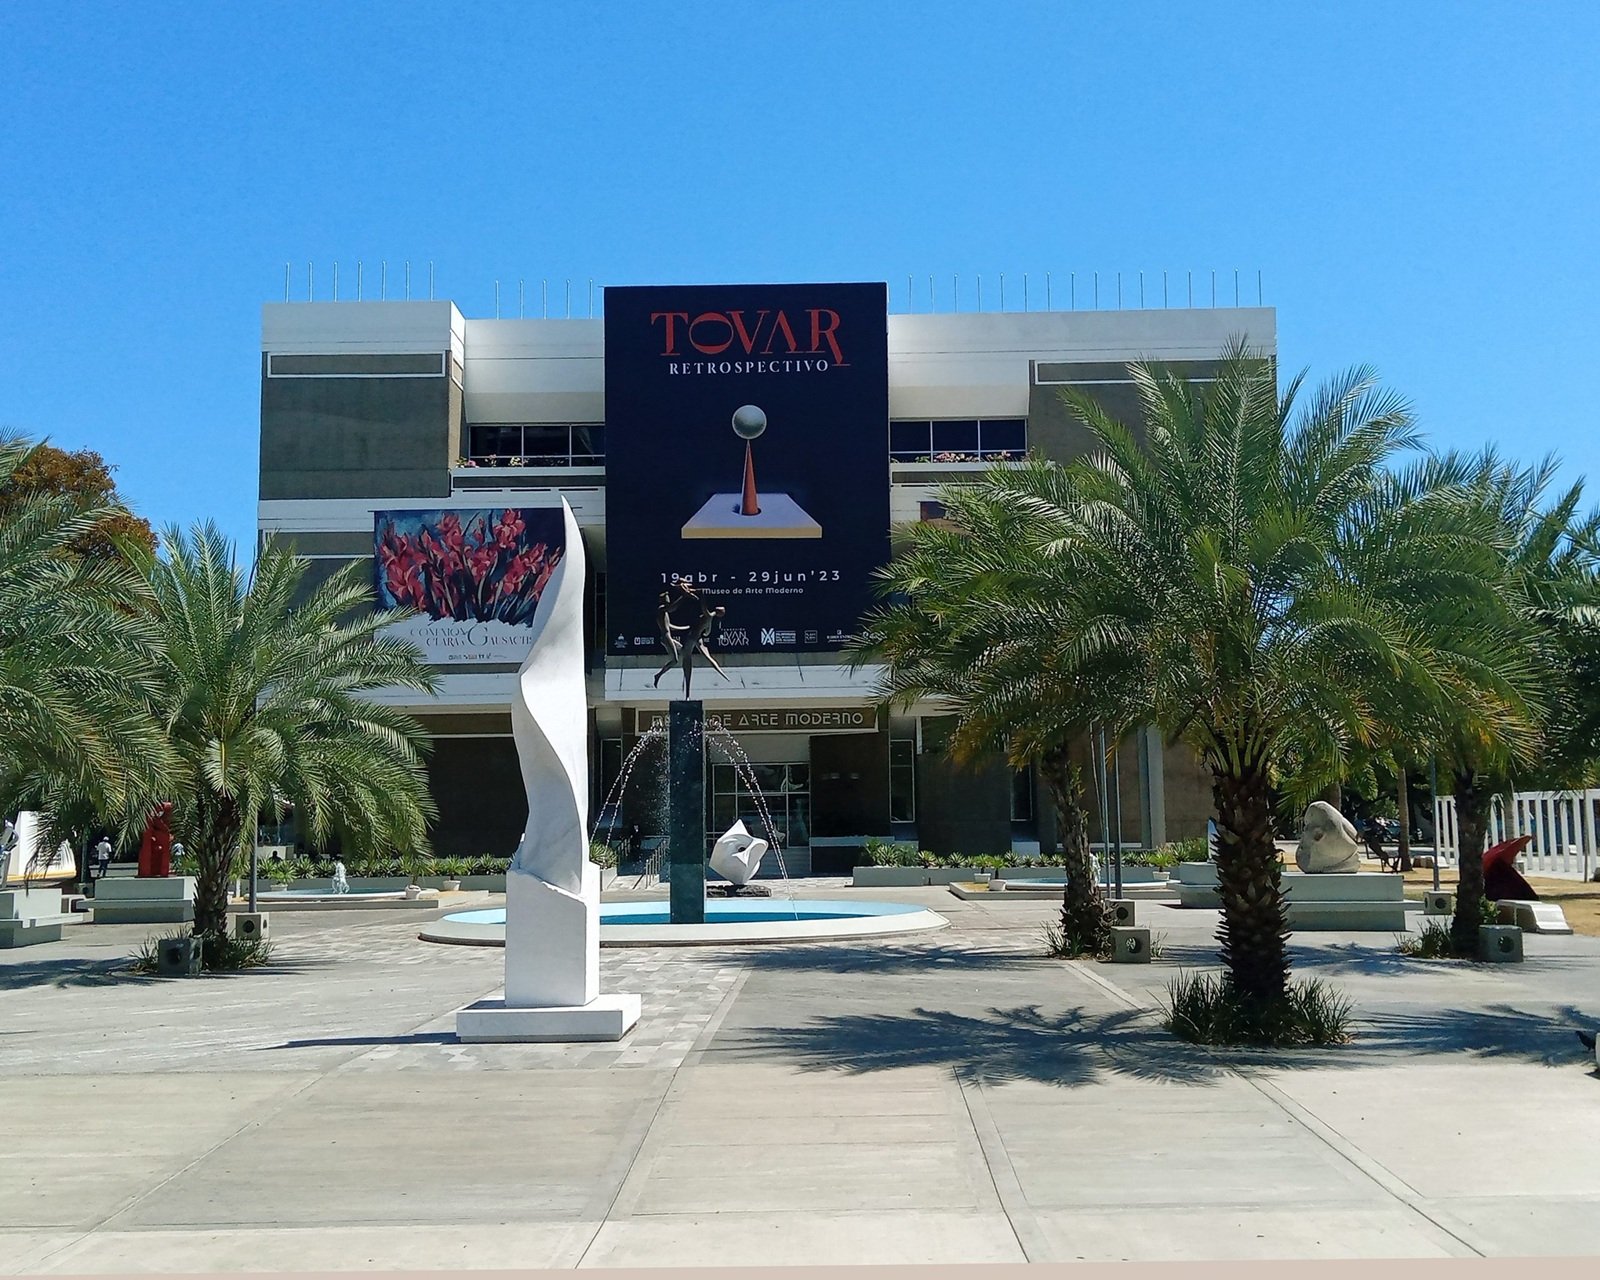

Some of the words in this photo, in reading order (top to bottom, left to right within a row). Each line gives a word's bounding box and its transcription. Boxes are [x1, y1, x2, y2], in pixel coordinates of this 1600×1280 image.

[651, 309, 851, 367] TOVAR
[669, 359, 829, 376] RETROSPECTIVO
[660, 571, 718, 584] 19abr
[702, 587, 731, 595] Museo
[732, 587, 742, 595] de
[745, 587, 763, 595] Arte
[765, 587, 804, 595] Moderno
[738, 713, 779, 726] ARTE
[785, 712, 863, 726] MODERNO
